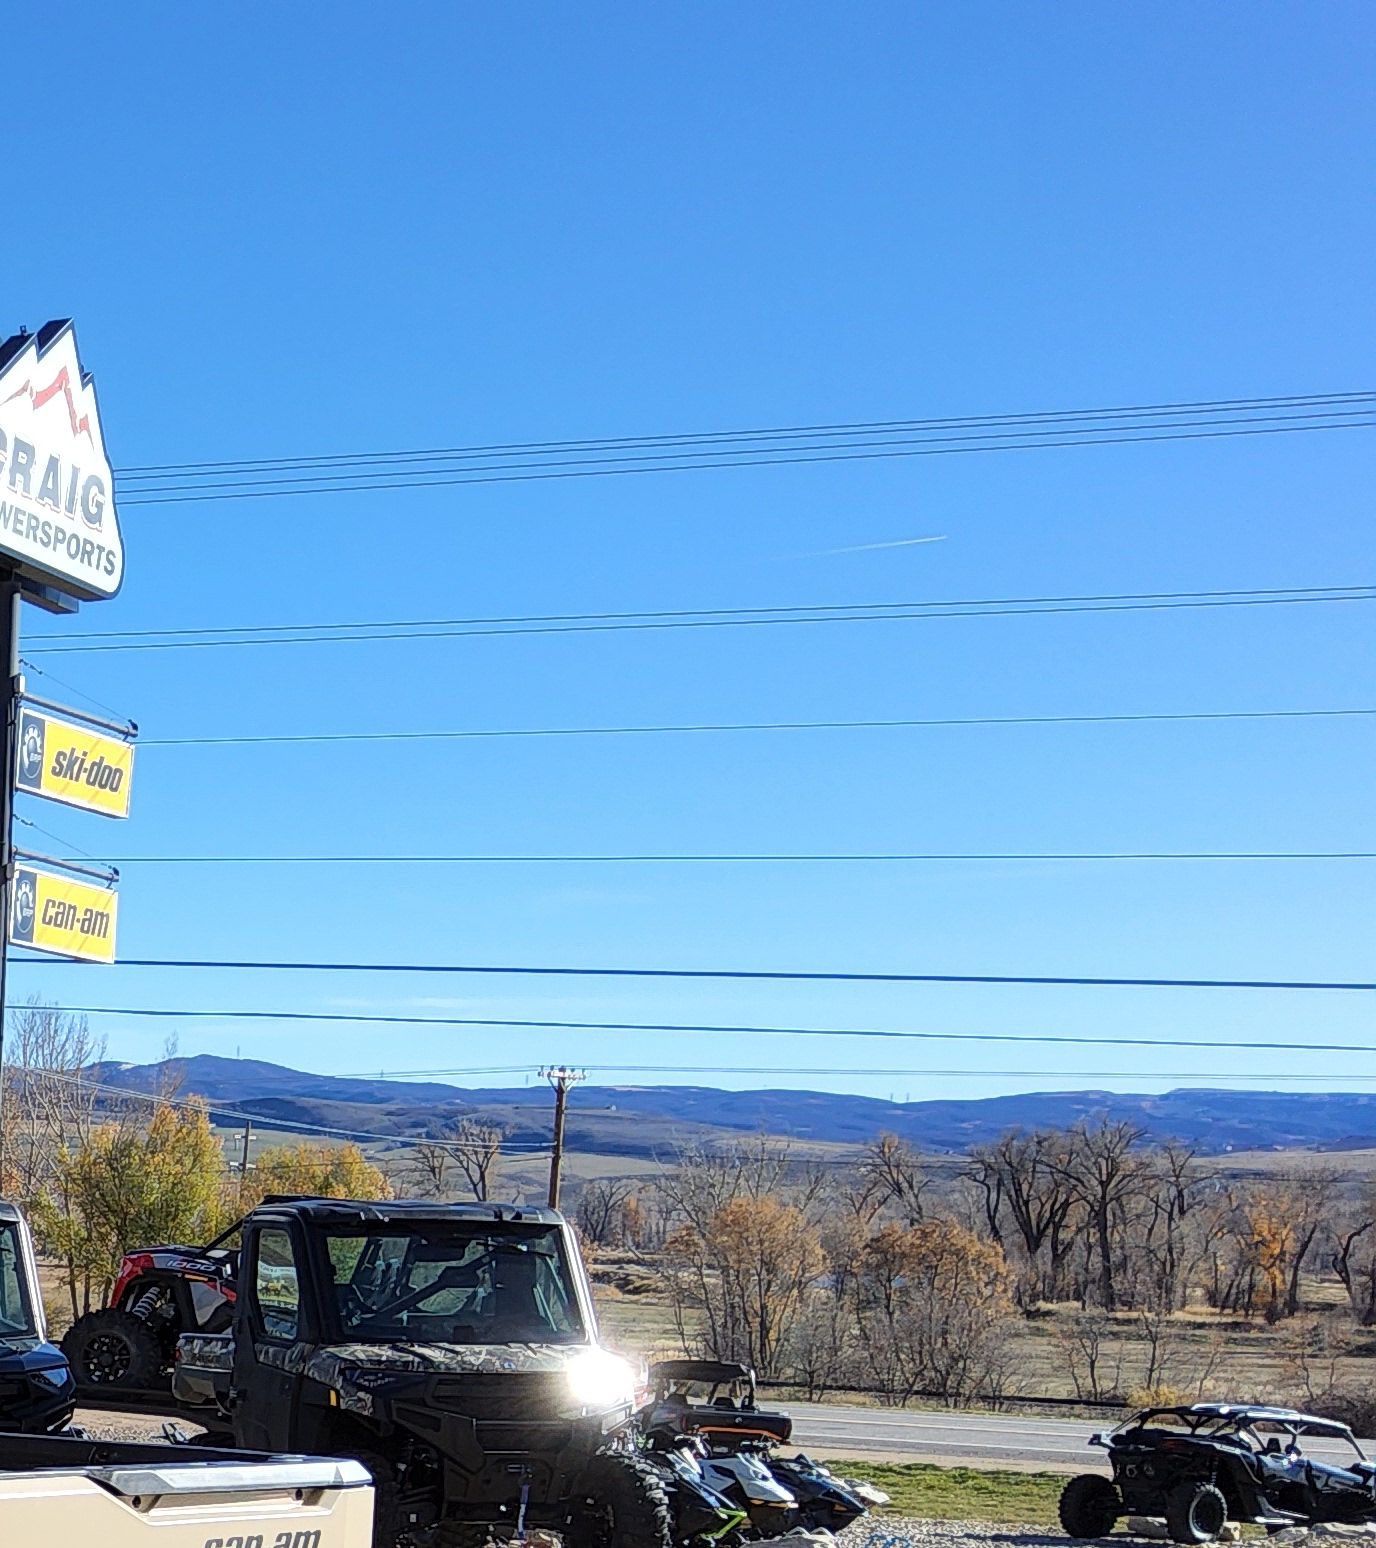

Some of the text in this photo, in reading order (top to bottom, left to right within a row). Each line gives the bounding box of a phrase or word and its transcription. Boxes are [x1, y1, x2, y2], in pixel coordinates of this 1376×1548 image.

[51, 747, 123, 793] ski-doo
[41, 898, 109, 939] can-am
[166, 1260, 216, 1271] 1000
